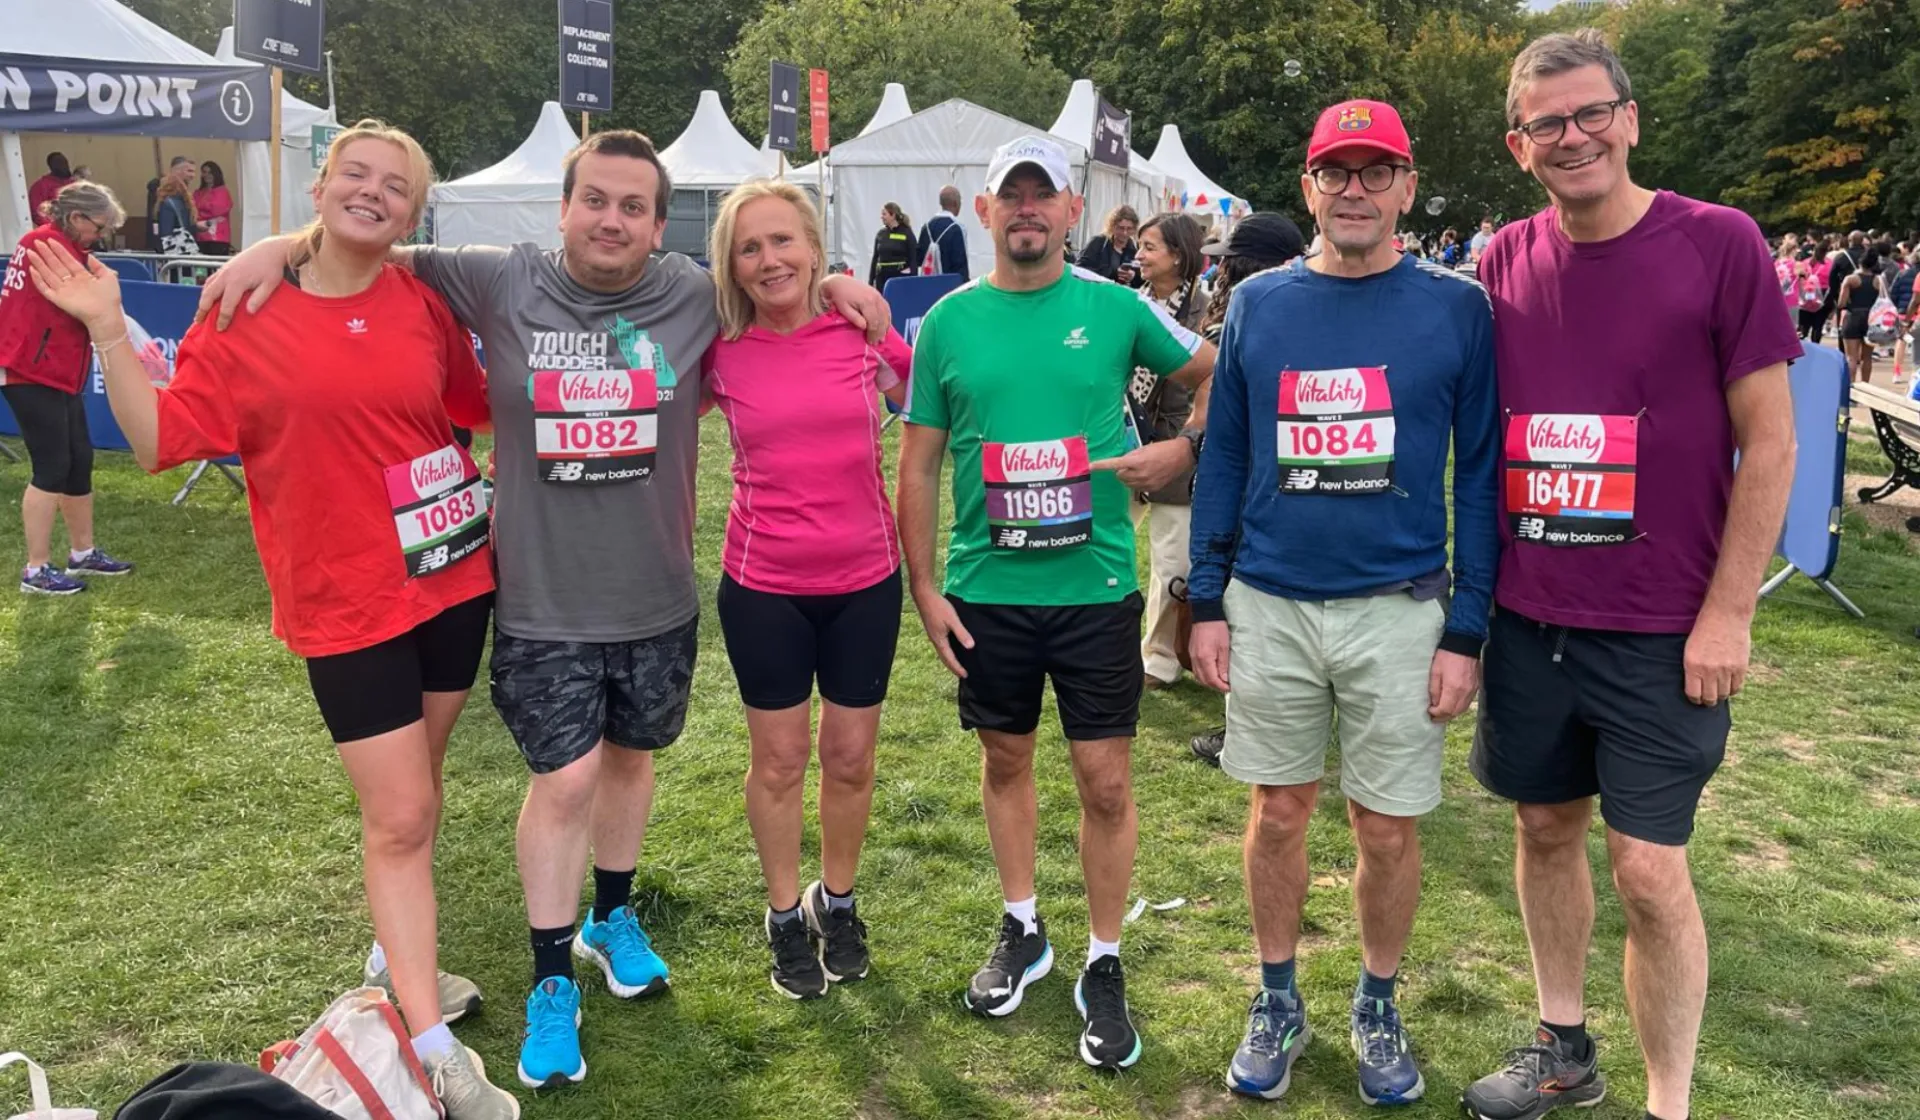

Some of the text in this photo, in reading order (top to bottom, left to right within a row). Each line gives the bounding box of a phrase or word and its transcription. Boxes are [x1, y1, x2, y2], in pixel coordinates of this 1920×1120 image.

[563, 25, 611, 43] REPLACEMENT
[577, 41, 597, 53] PACK
[566, 53, 608, 69] COLLECTION
[47, 69, 198, 119] POINT
[531, 331, 609, 357] TOUGH
[527, 354, 608, 371] MUDDER
[562, 371, 630, 407] Vitality
[1298, 373, 1363, 410] Vitality
[555, 419, 638, 450] 1082
[1289, 422, 1377, 456] 1084
[1530, 416, 1601, 460] Vitality
[413, 453, 463, 488] Vitality
[585, 470, 607, 482] new
[609, 466, 650, 479] balance
[1004, 445, 1066, 477] Vitality
[437, 489, 450, 499] WAVE
[1319, 480, 1342, 490] new
[1344, 477, 1390, 490] balance
[1526, 471, 1604, 508] 16477
[415, 490, 476, 538] 1083
[1003, 486, 1074, 519] 11966
[450, 550, 465, 561] new
[464, 533, 488, 553] balance
[1028, 539, 1050, 548] new
[1050, 533, 1088, 547] balance
[1545, 532, 1569, 542] new
[1570, 531, 1625, 543] balance
